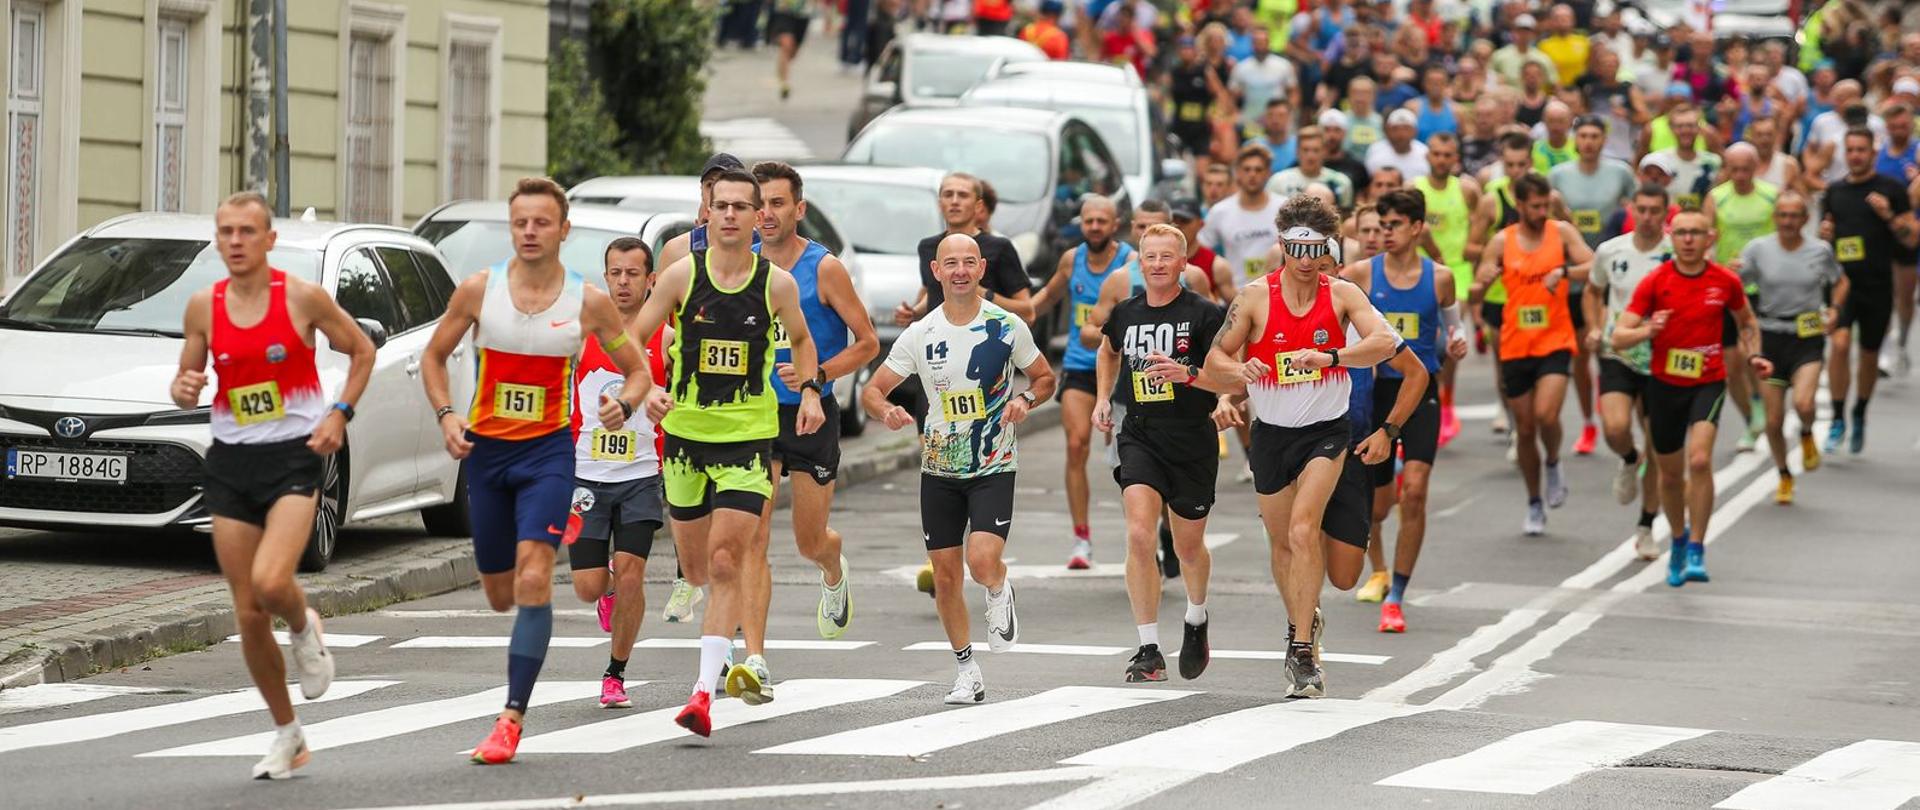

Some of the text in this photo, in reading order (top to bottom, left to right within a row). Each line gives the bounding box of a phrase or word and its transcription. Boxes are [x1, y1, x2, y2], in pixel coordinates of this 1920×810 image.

[1176, 321, 1190, 331] LAT
[926, 340, 949, 361] 14
[1123, 323, 1174, 361] 450
[708, 346, 740, 368] 315
[241, 390, 275, 416] 429
[504, 389, 534, 413] 151
[949, 394, 977, 416] 161
[600, 433, 629, 455] 199
[21, 453, 122, 478] RP 1884G
